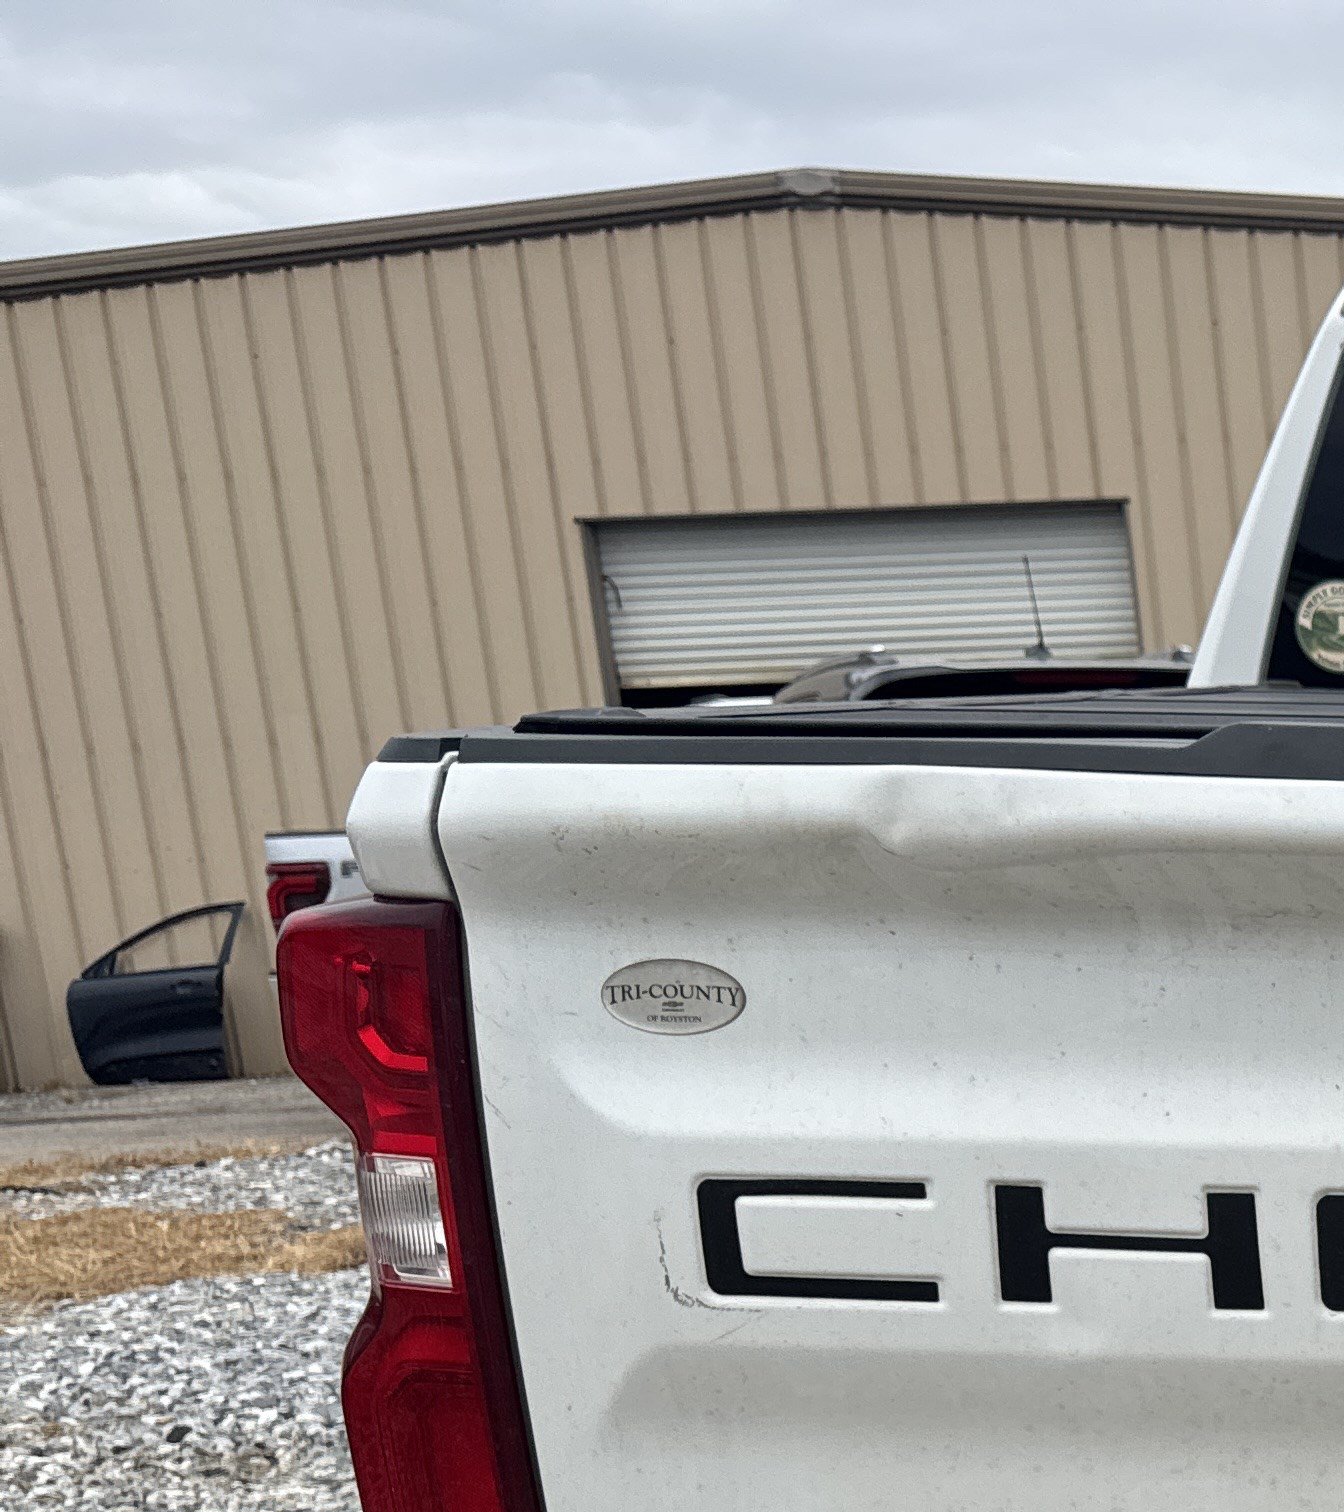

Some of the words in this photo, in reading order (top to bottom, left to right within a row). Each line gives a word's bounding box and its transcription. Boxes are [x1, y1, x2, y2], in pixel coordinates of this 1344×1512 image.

[606, 983, 740, 1007] TRI-COUNTY
[646, 1015, 659, 1023] OF
[660, 1015, 702, 1023] ROYSTON
